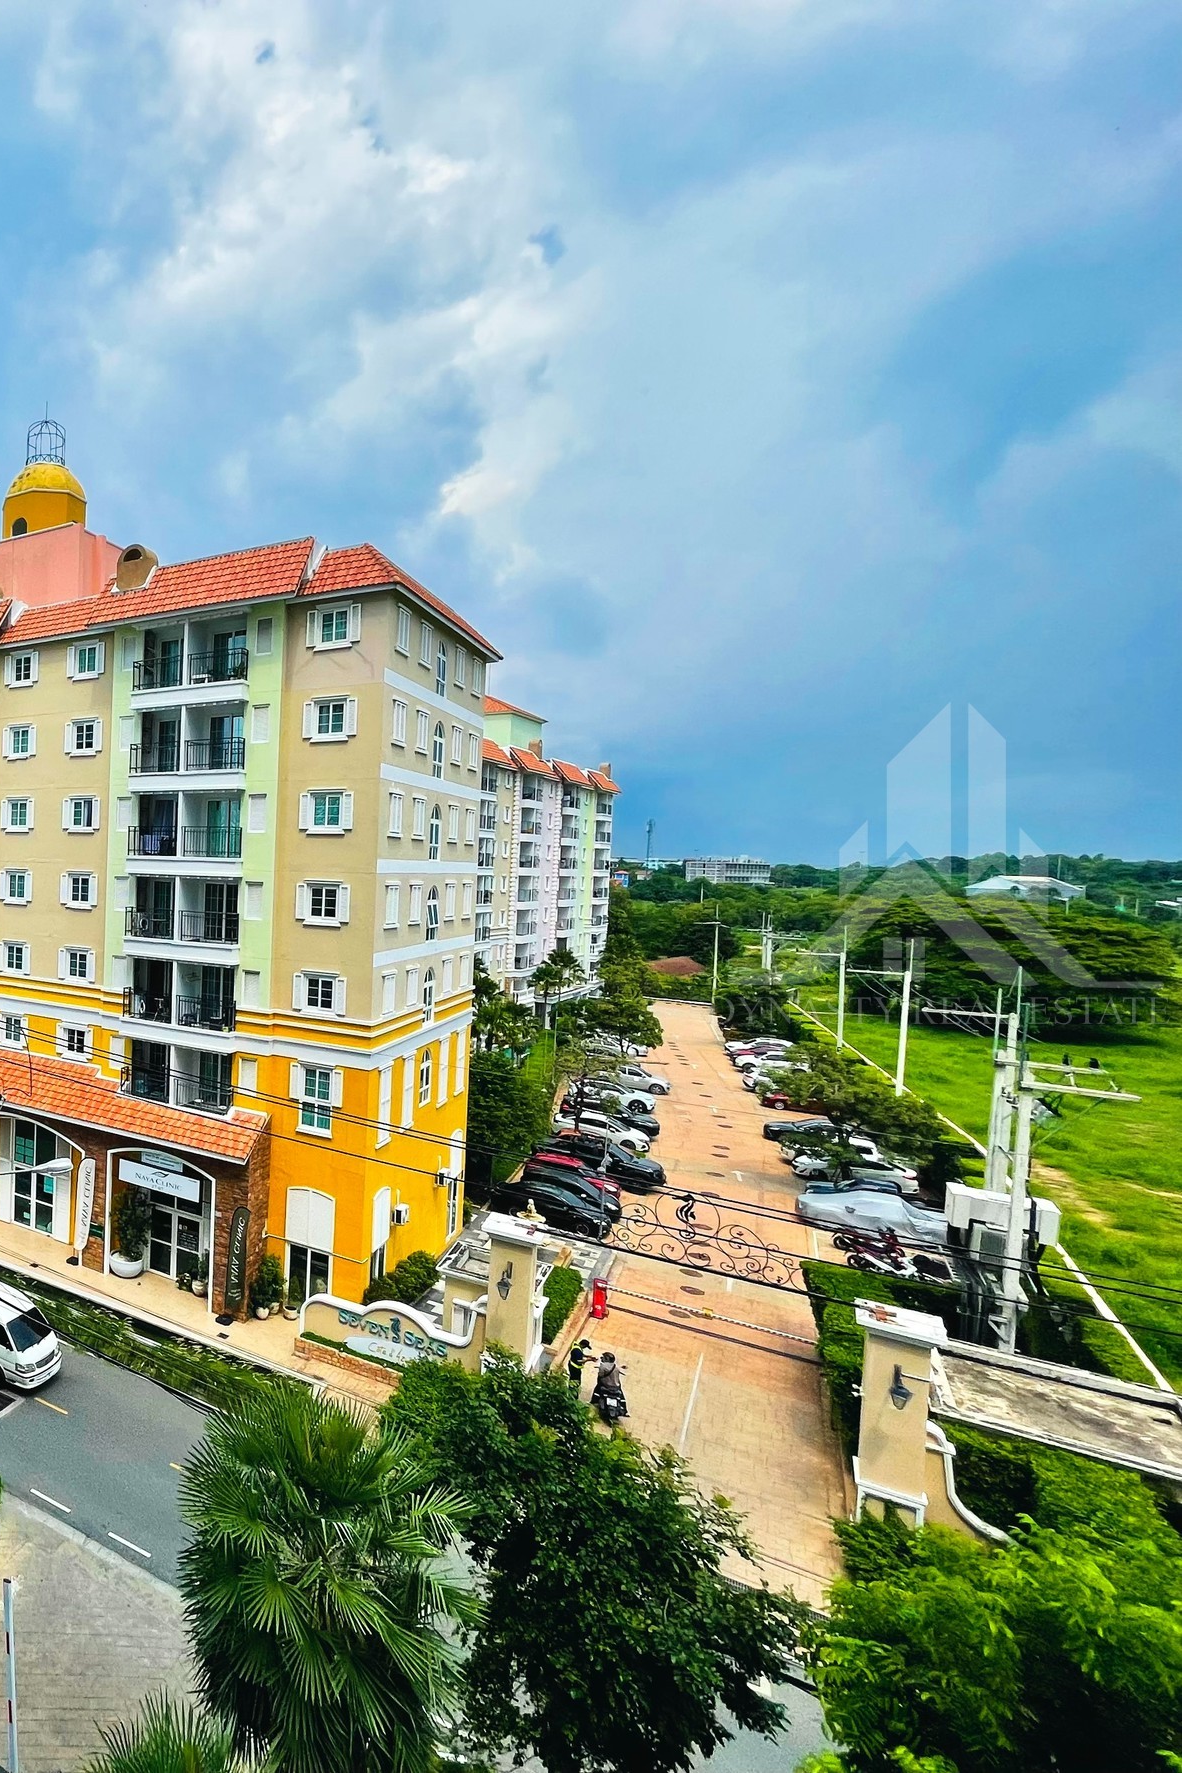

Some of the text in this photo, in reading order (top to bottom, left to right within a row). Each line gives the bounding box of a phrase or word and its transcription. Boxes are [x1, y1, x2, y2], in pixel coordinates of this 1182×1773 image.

[134, 1172, 155, 1184] NAYA
[155, 1178, 183, 1192] CLINIC
[338, 1309, 448, 1357] SEVEN SEAS
